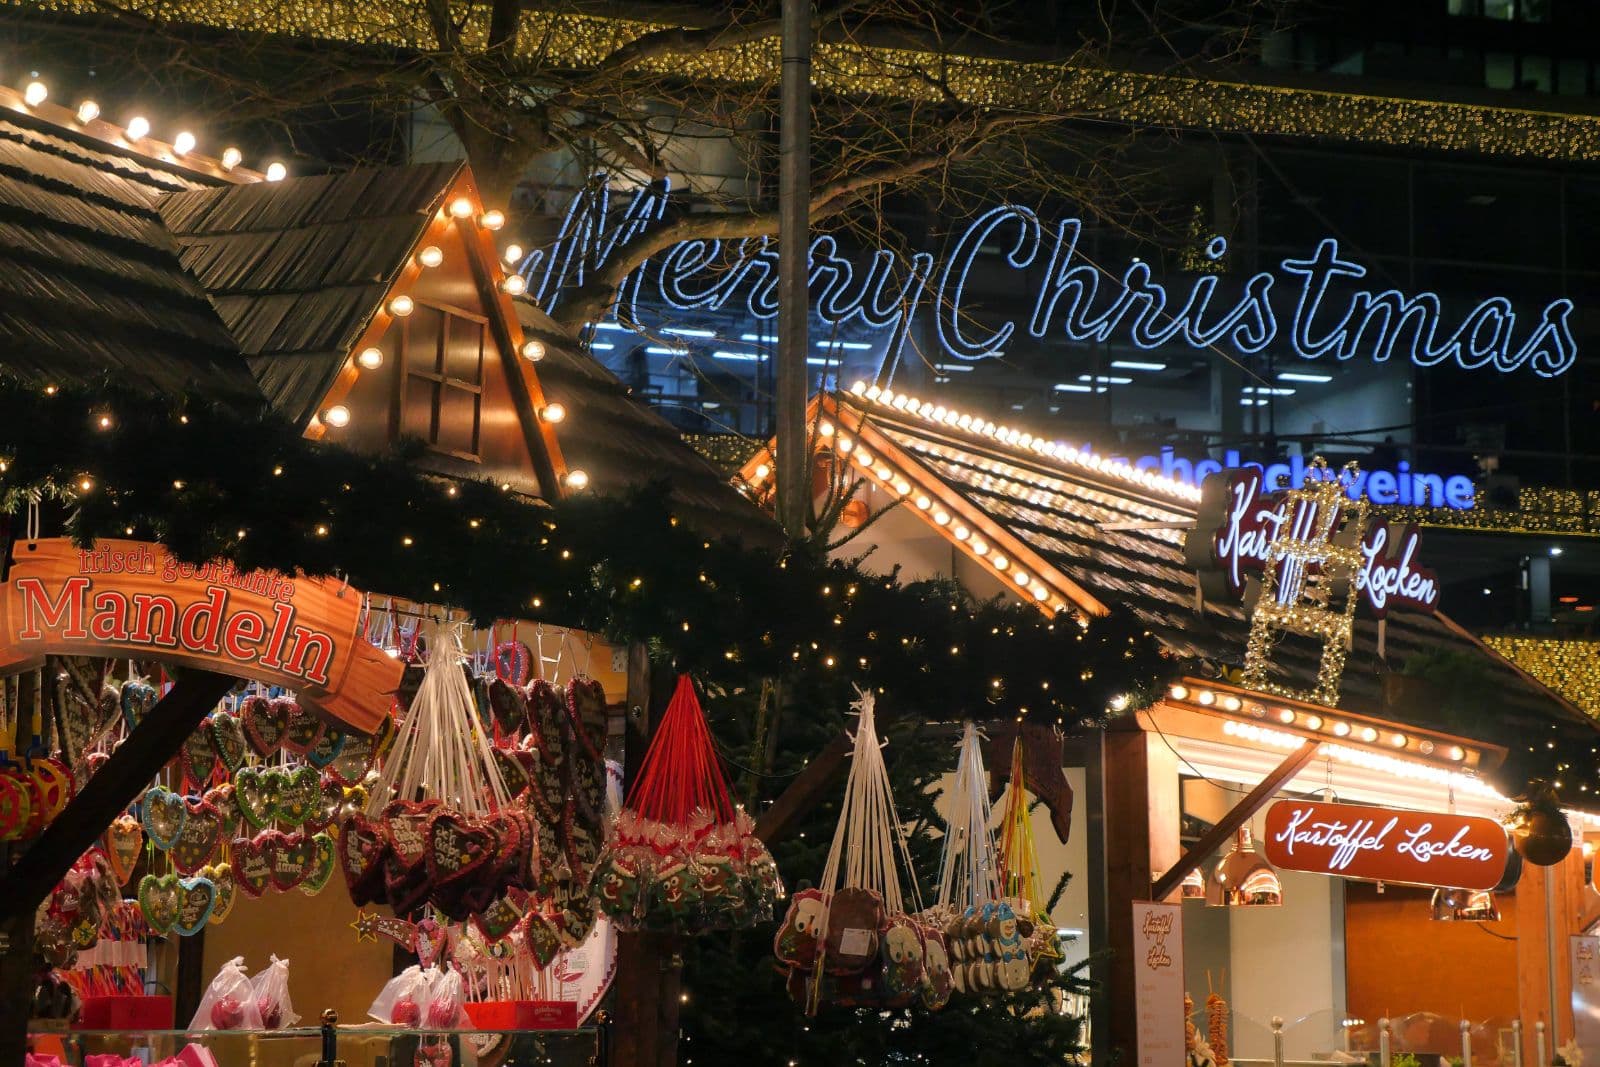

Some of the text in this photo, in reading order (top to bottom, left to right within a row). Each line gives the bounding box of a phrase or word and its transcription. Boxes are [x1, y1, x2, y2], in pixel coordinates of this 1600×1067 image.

[517, 172, 1578, 390] Merry Christmas
[79, 543, 156, 575] frisch
[1358, 527, 1436, 609] Locken
[16, 577, 335, 685] Mandeln
[1275, 807, 1494, 870] Kartoffel Locken
